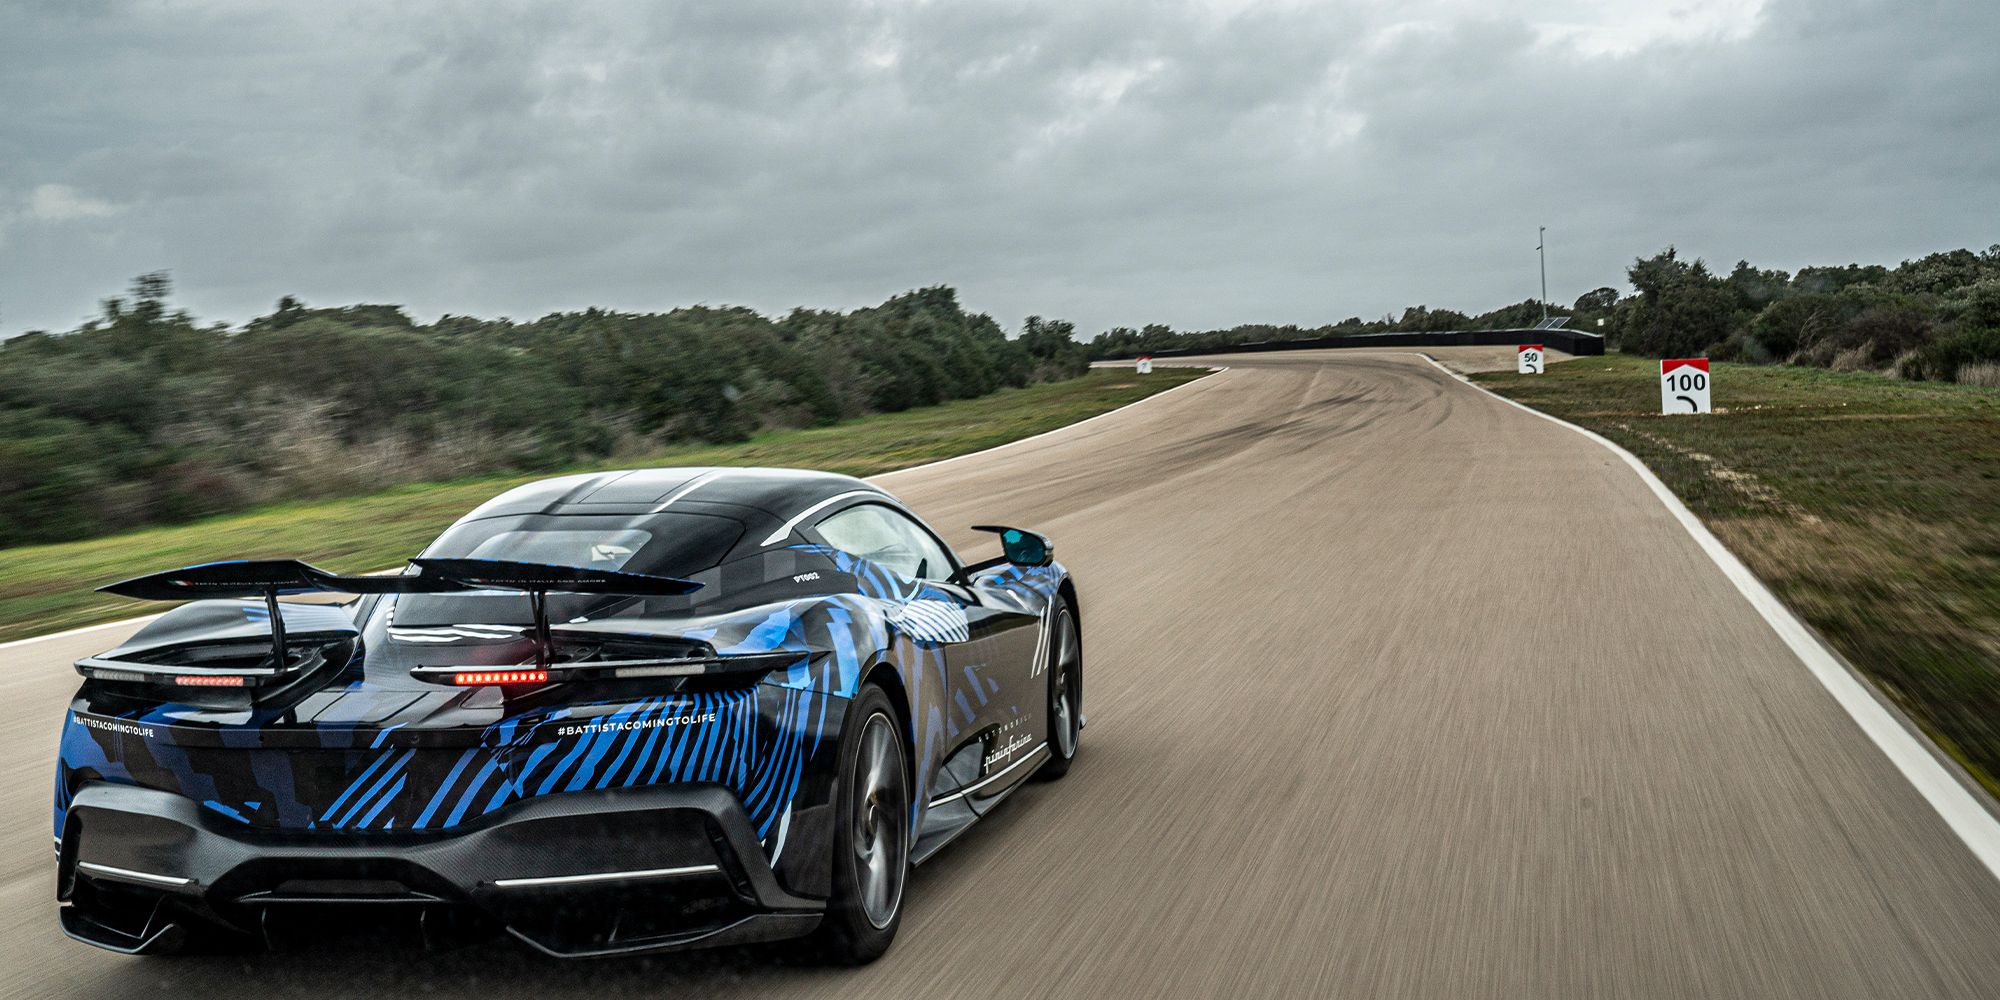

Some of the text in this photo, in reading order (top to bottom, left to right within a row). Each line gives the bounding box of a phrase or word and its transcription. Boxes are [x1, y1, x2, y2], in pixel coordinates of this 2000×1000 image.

[1524, 353, 1538, 362] 50
[1666, 374, 1706, 391] 100
[73, 716, 154, 738] #BATTISTACOMINGTOLIFE
[557, 712, 716, 736] #BATTISTACOMINGTOLIFE
